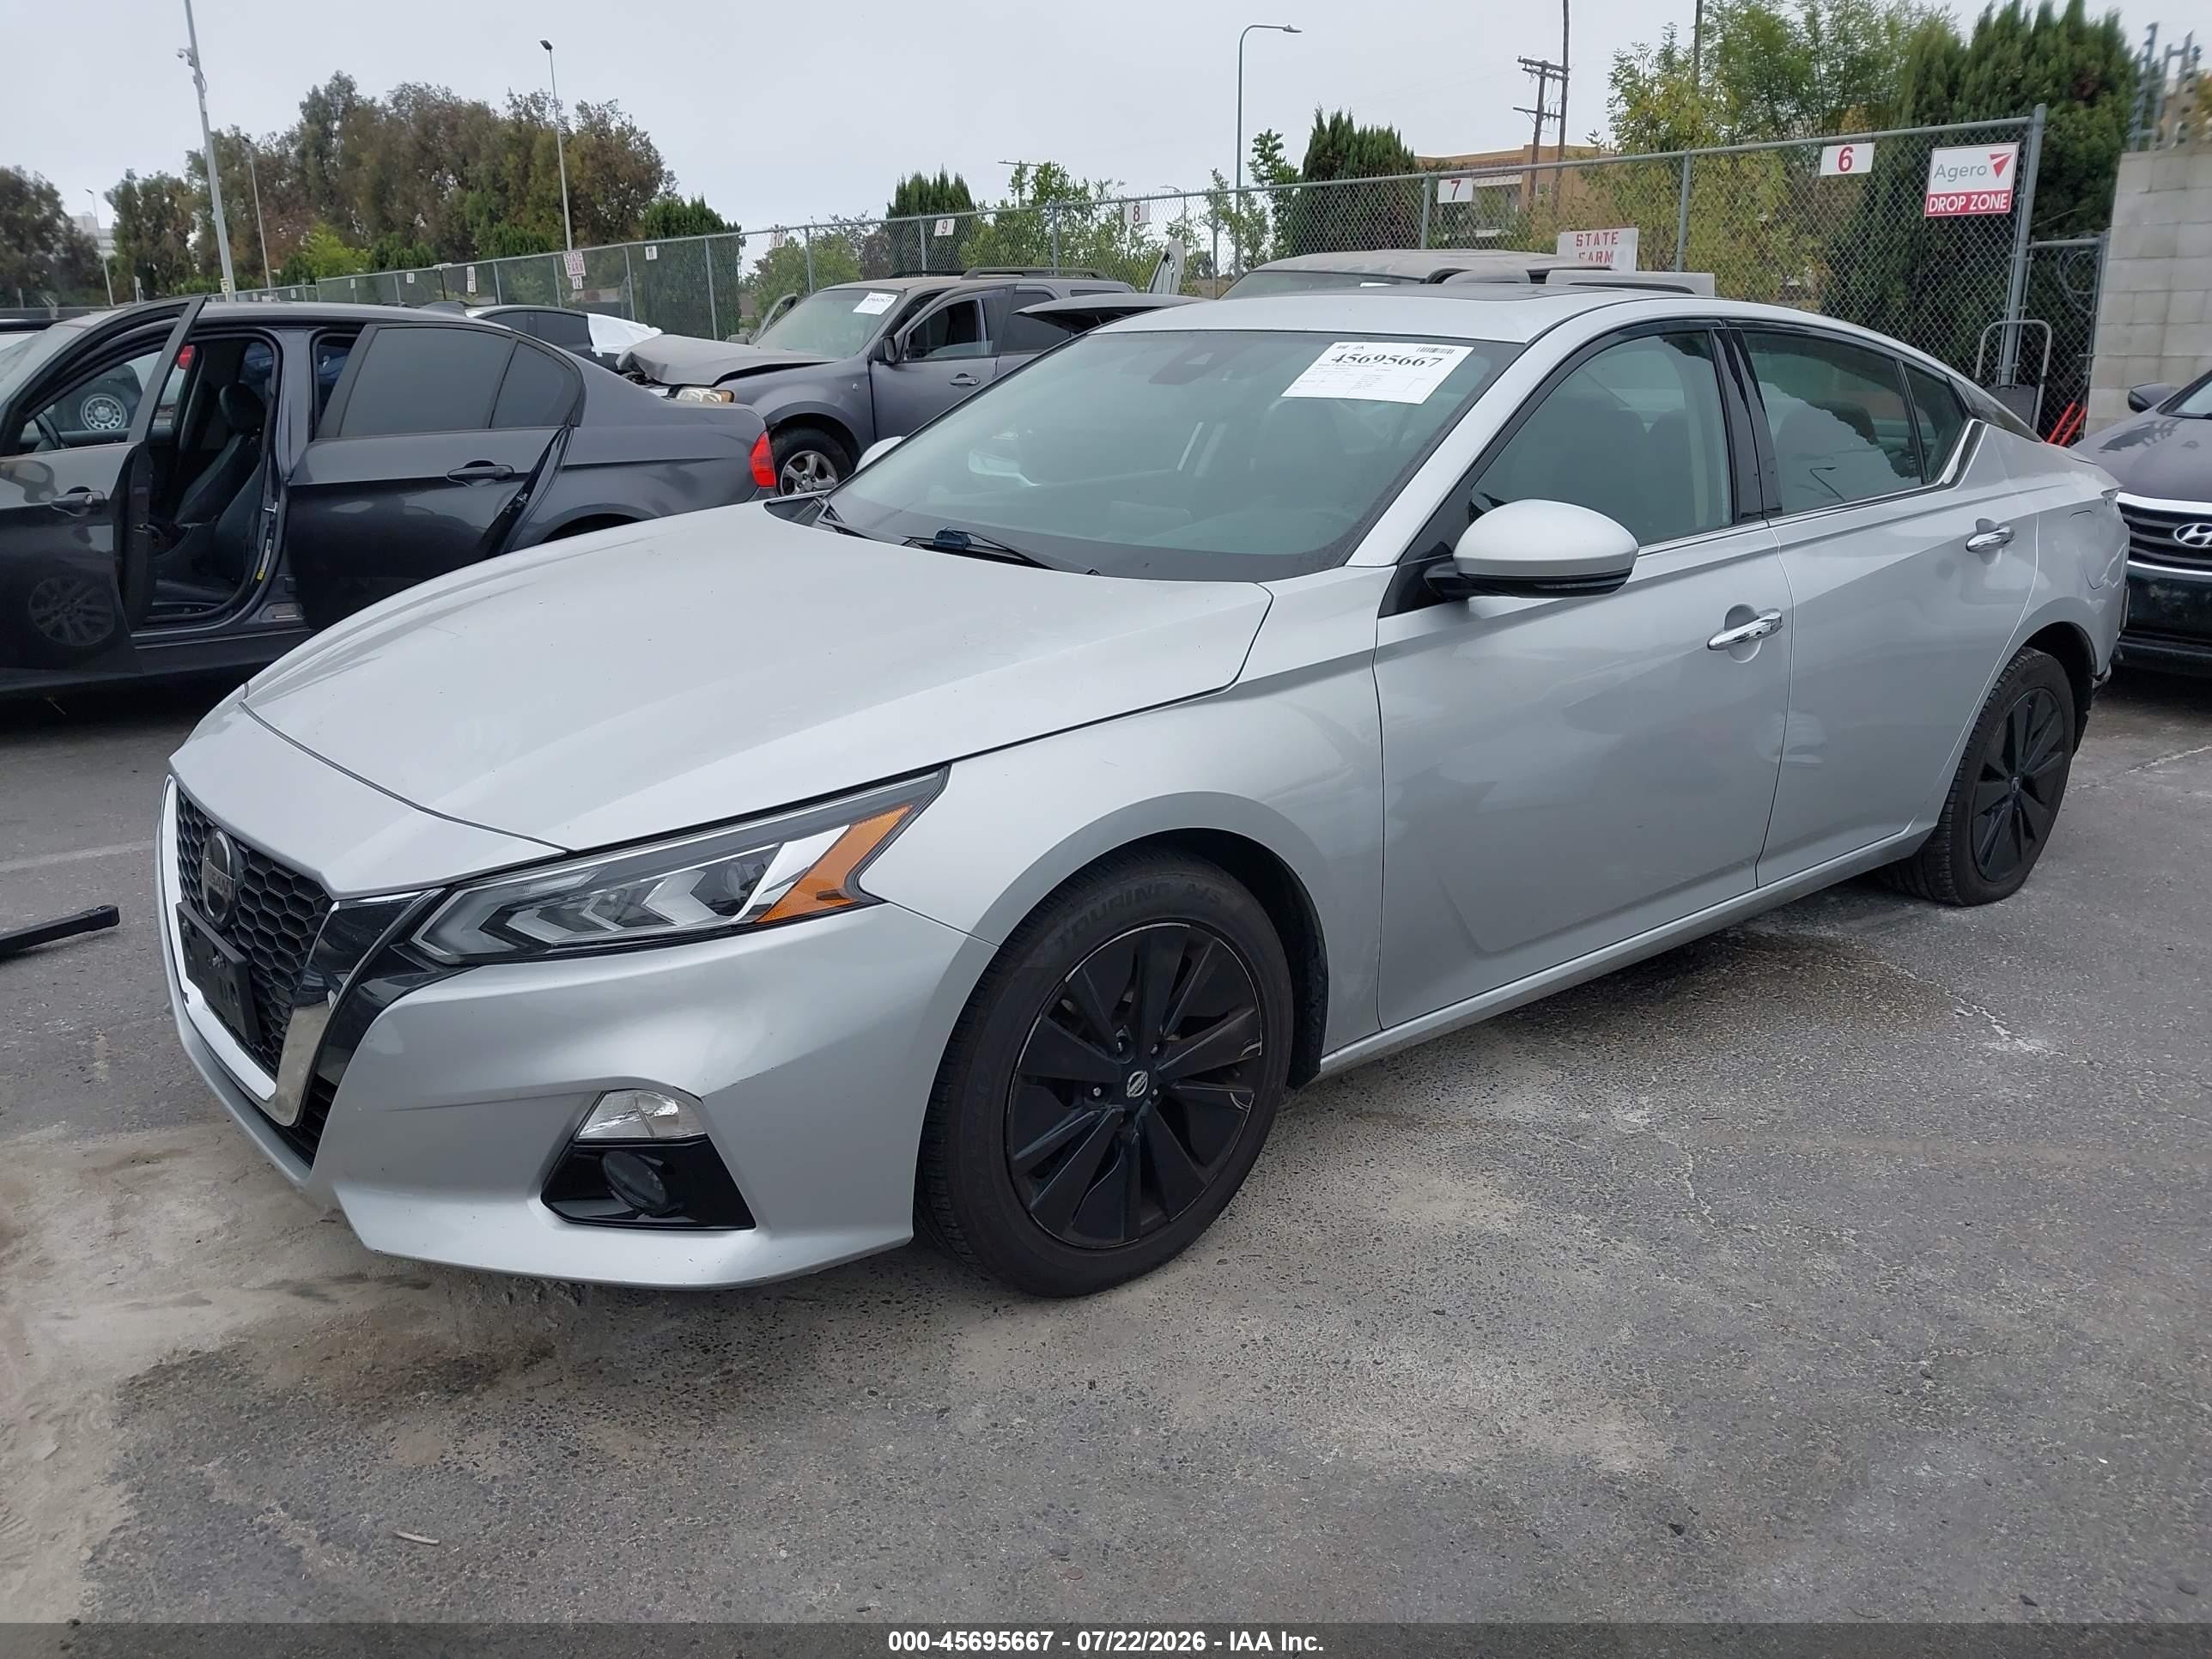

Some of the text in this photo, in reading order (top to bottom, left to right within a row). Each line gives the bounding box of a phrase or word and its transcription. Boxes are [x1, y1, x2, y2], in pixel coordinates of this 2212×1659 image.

[1838, 146, 1854, 172] 6
[1933, 164, 1987, 183] Agero
[1451, 179, 1462, 201] 7
[1928, 193, 2008, 213] DROP ZONE
[1133, 204, 1140, 222] 8
[940, 220, 948, 234] 9
[774, 233, 783, 247] 10
[1576, 231, 1619, 246] STATE
[574, 276, 581, 289] 12
[1330, 352, 1446, 368] 45695667
